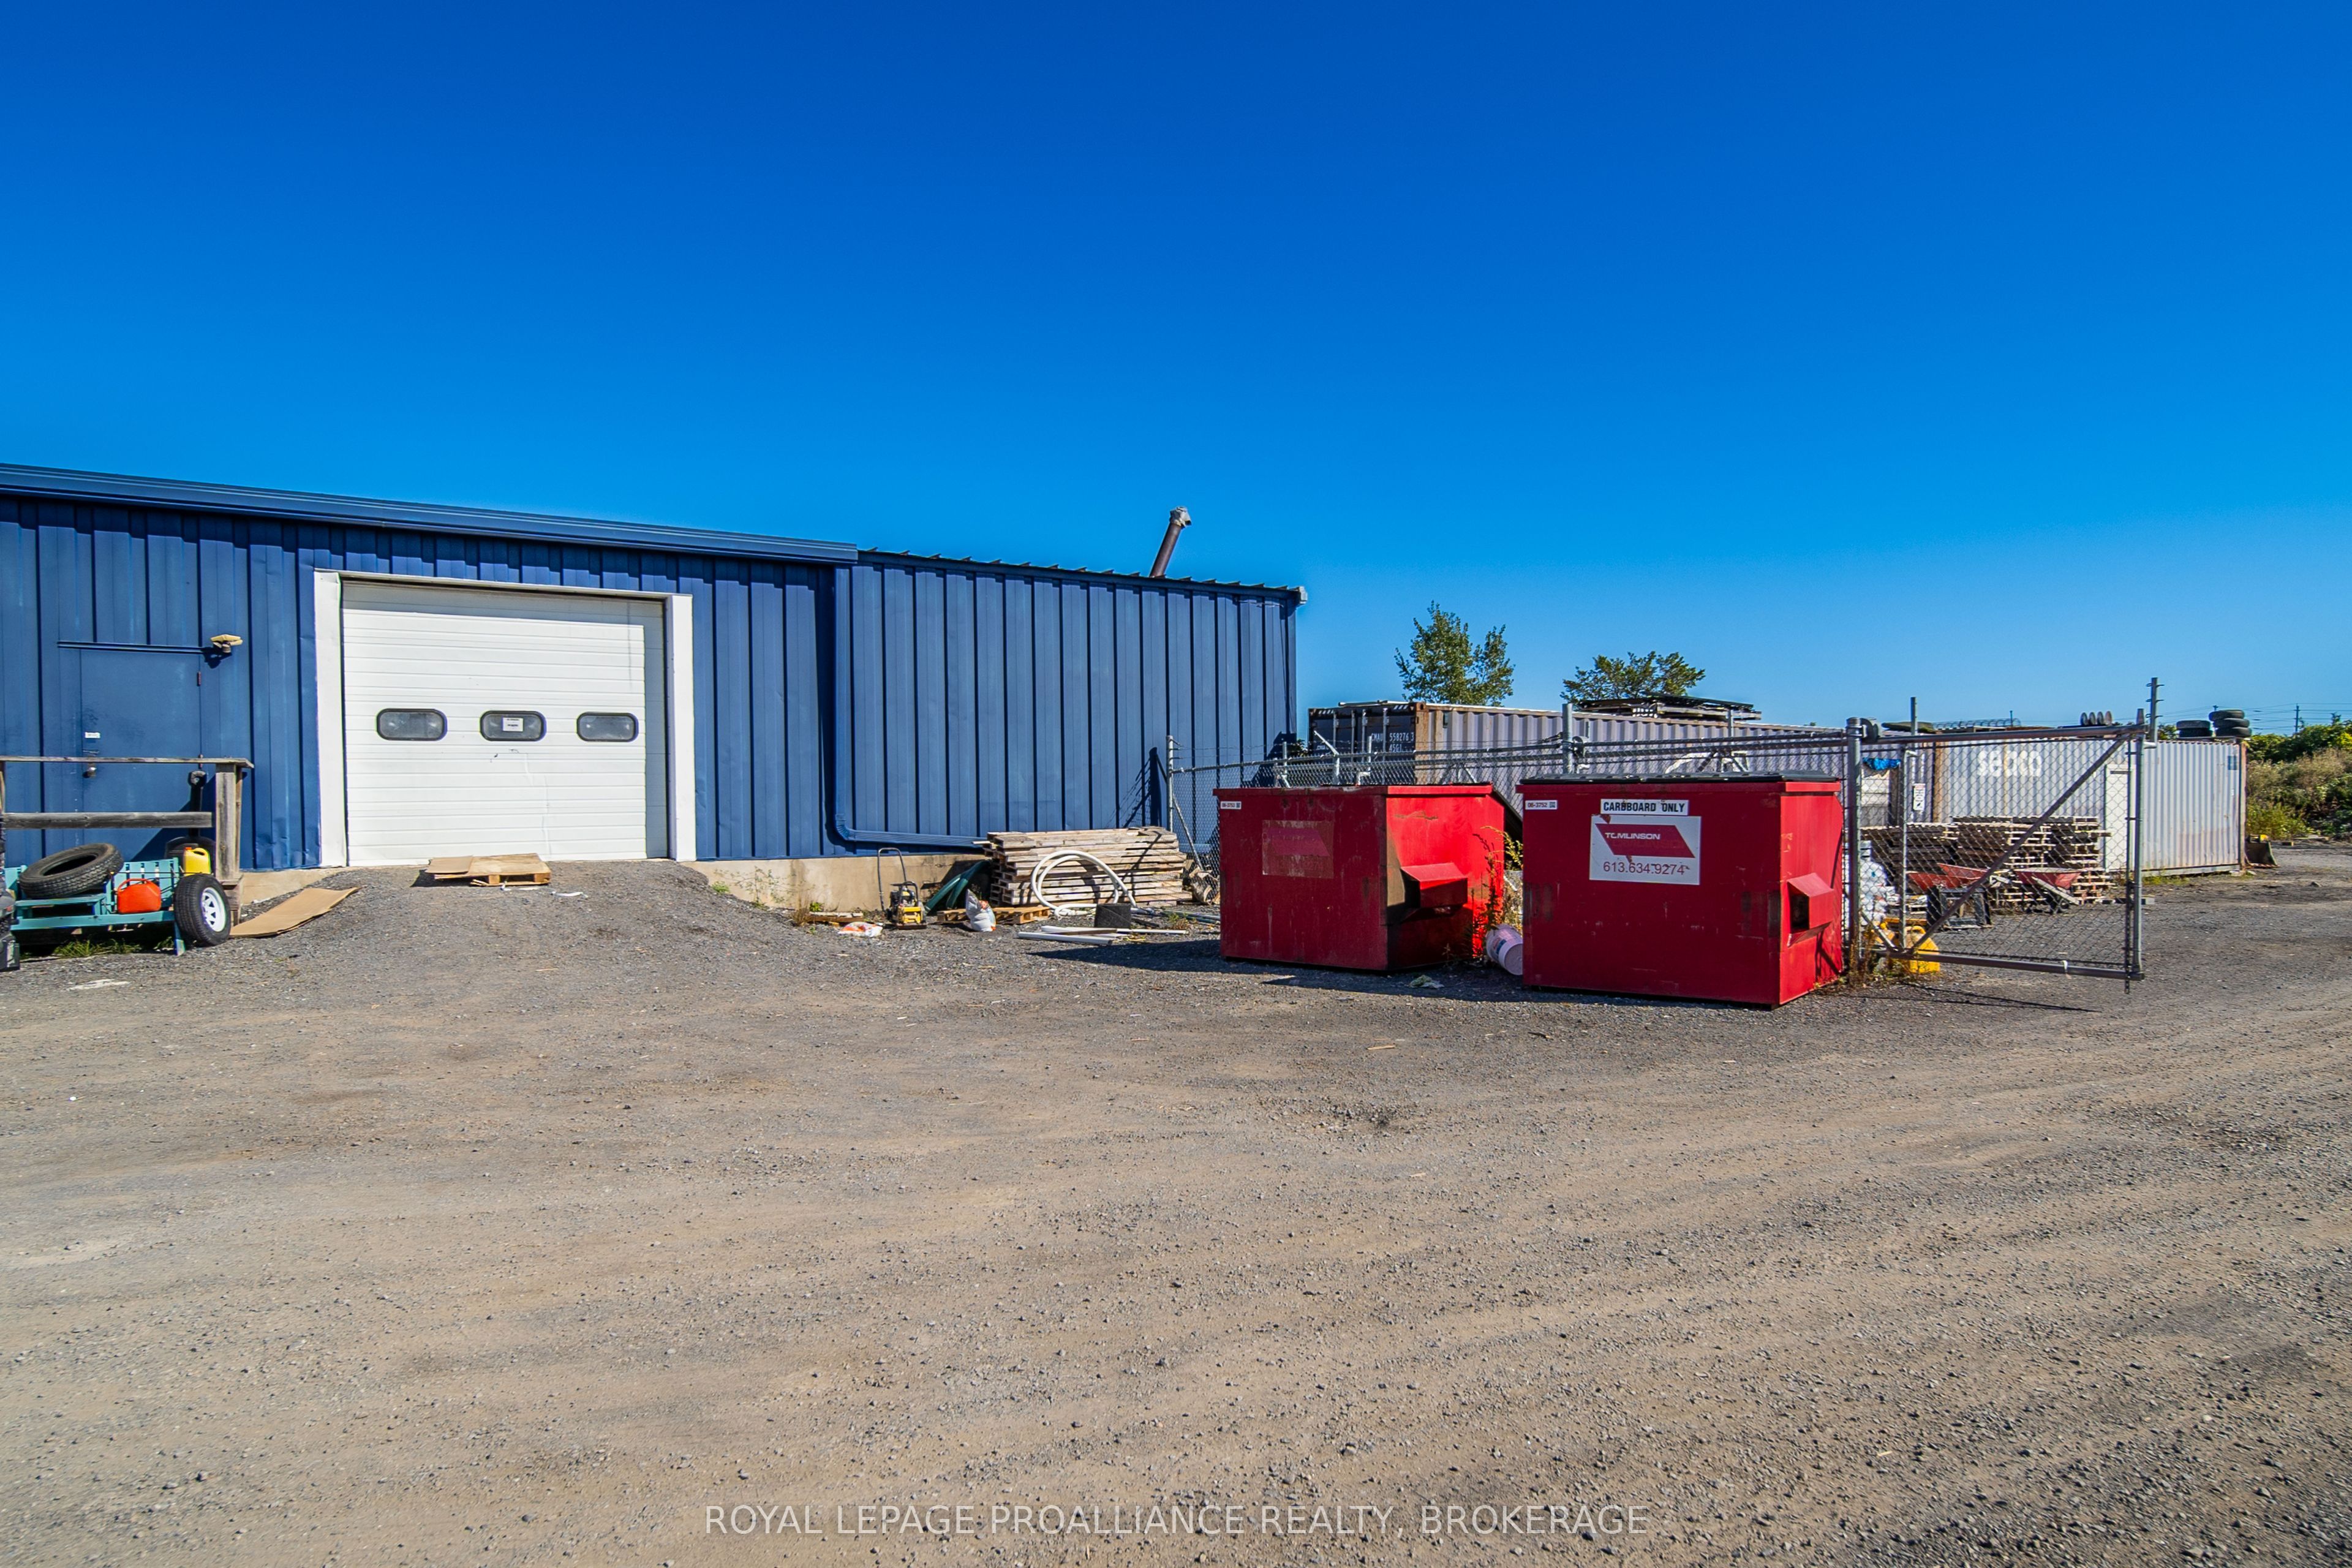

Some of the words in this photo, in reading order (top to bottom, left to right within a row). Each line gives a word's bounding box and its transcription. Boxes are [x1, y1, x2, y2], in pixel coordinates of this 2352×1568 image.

[1604, 802, 1656, 812] CARDBOARD
[1661, 803, 1685, 812] ONLY
[1603, 861, 1685, 875] 613.634.9274
